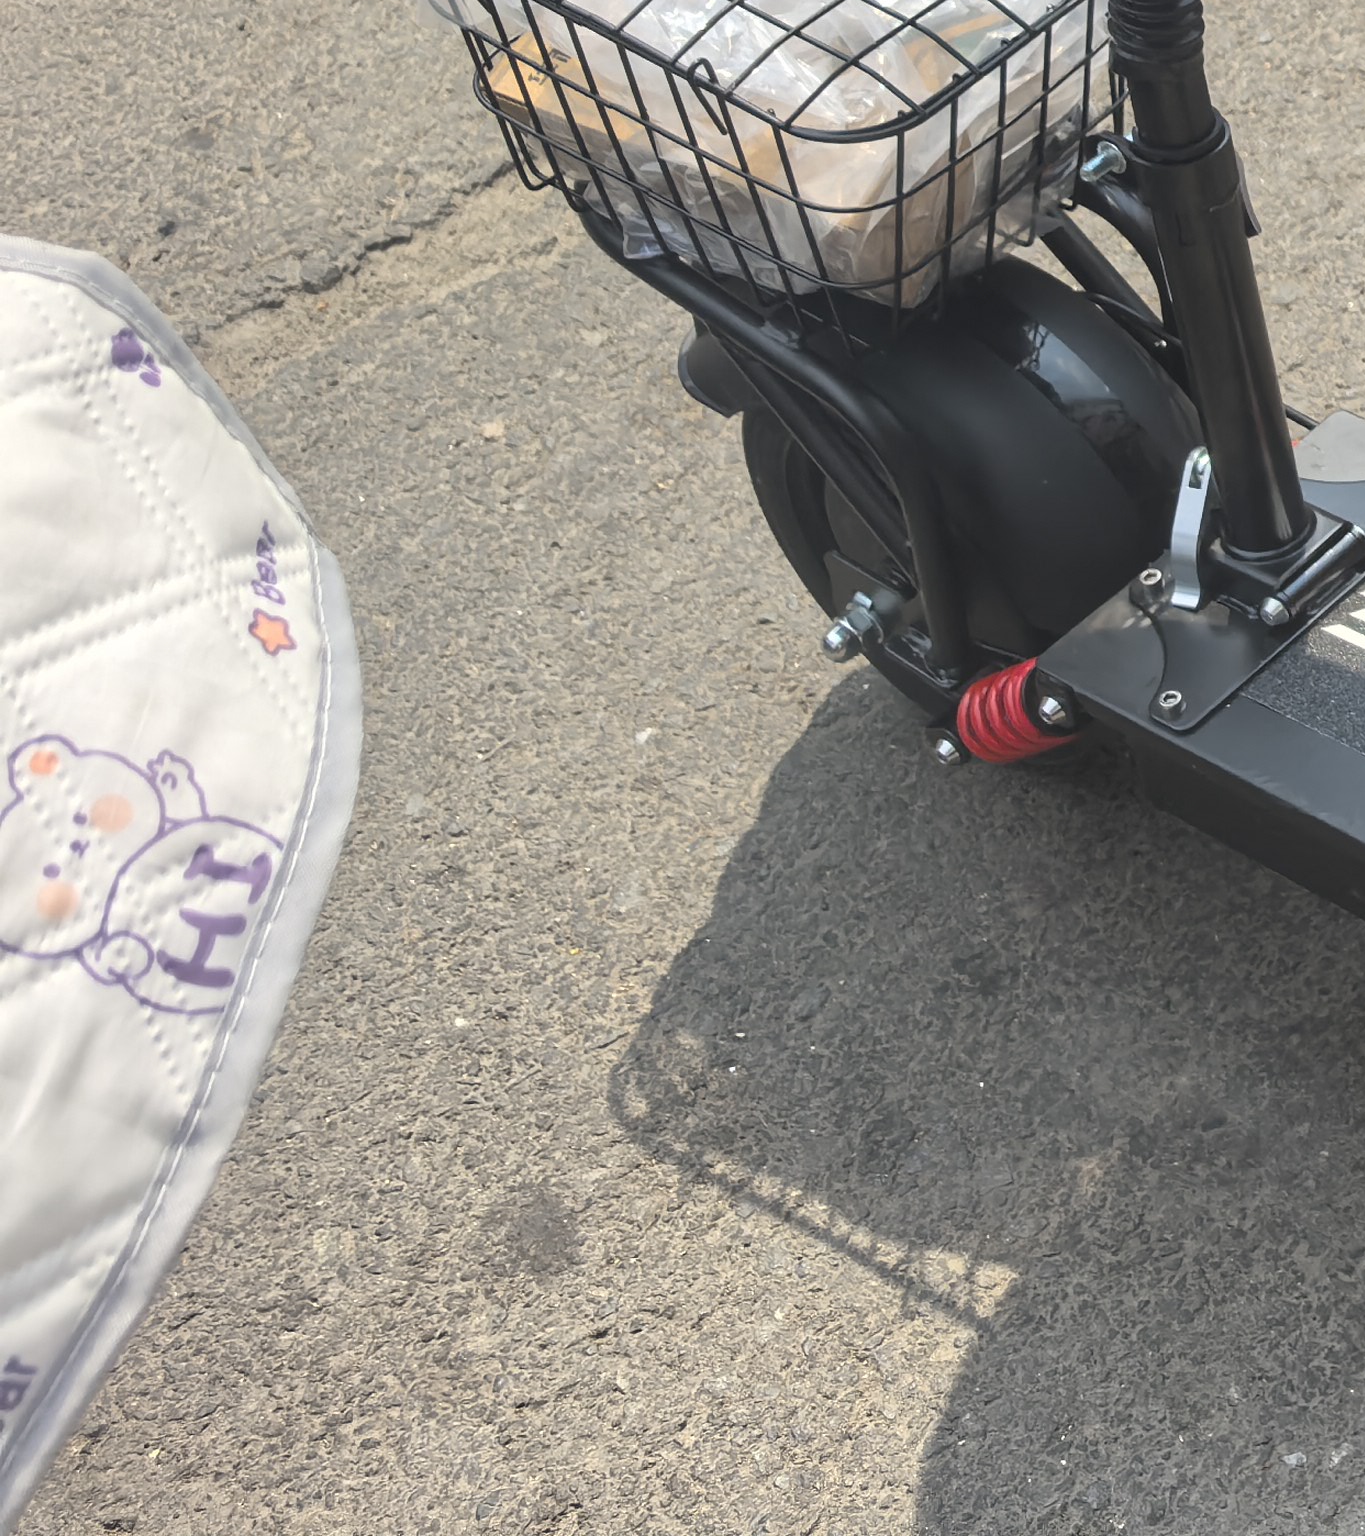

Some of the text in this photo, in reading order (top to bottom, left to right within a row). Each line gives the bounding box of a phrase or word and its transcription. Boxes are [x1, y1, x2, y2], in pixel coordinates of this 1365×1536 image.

[251, 519, 286, 605] Bear
[156, 844, 272, 988] HI
[0, 1353, 38, 1434] ar
